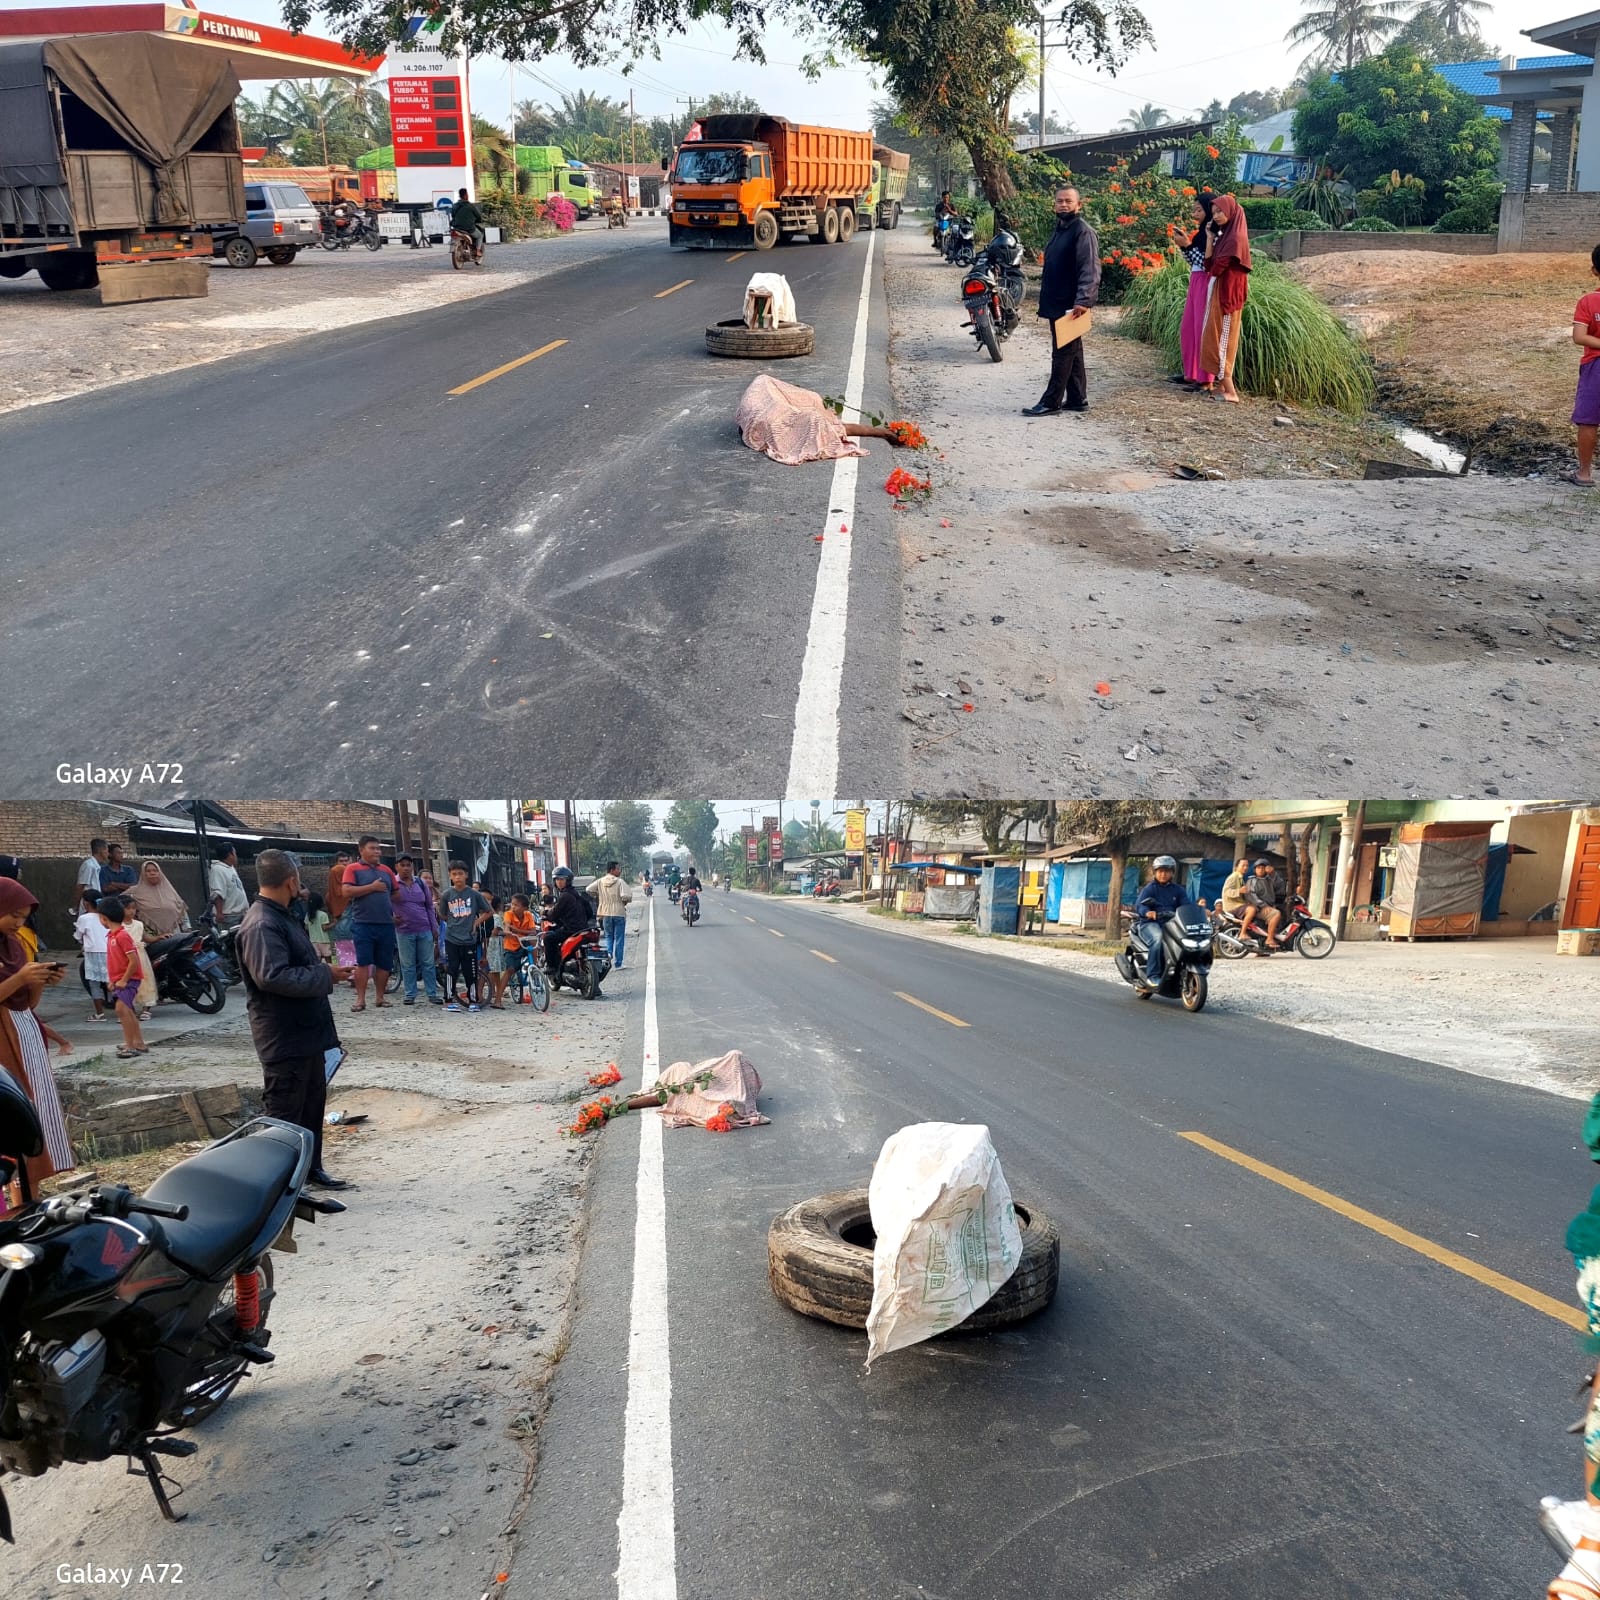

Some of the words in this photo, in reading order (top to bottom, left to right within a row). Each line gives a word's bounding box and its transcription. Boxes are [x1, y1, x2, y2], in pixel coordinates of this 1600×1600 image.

[203, 19, 262, 43] PERTAMINA
[394, 45, 446, 54] PETAMIN
[403, 64, 443, 72] 14.206.1107
